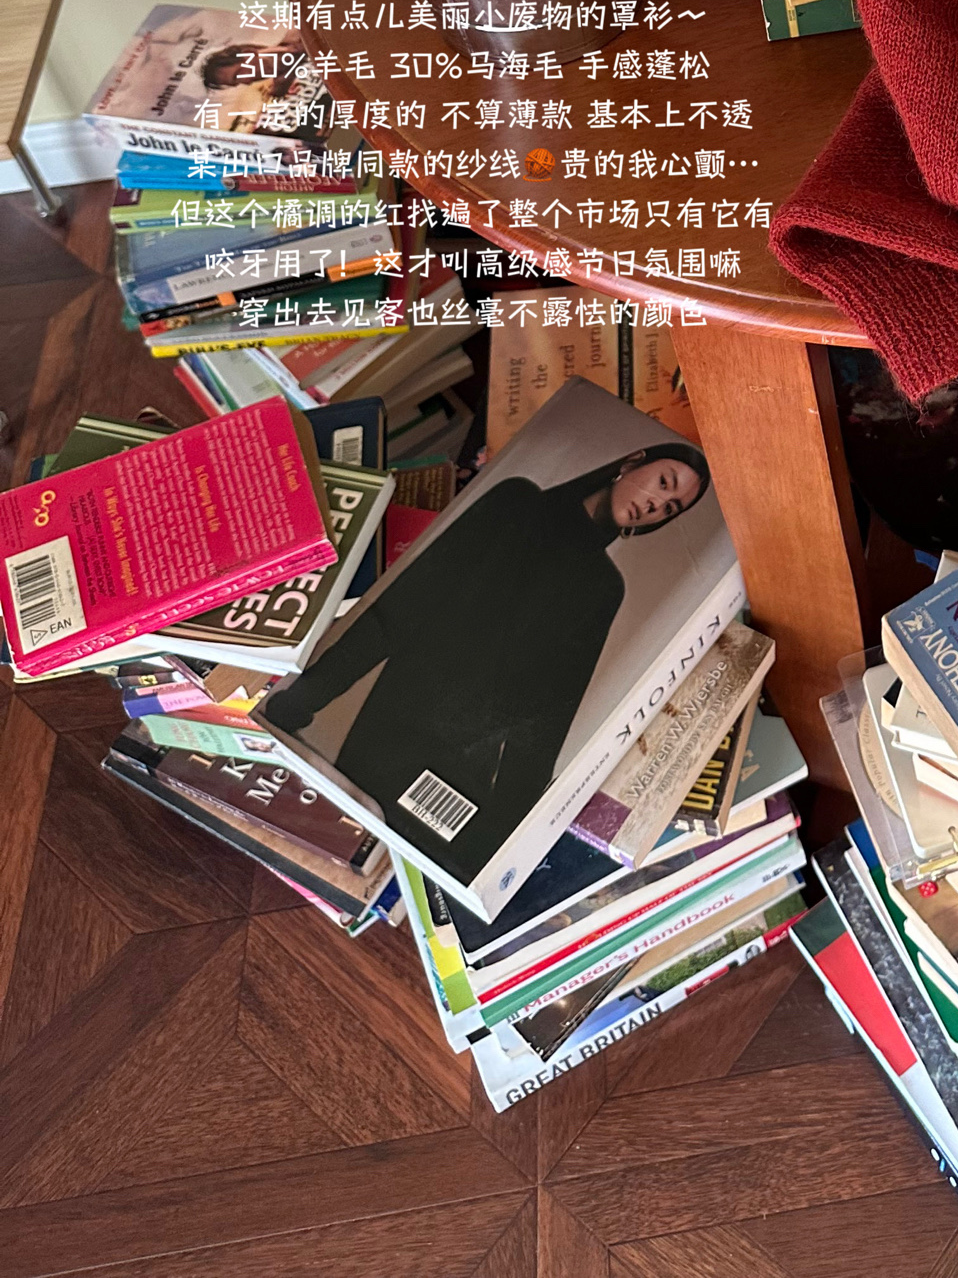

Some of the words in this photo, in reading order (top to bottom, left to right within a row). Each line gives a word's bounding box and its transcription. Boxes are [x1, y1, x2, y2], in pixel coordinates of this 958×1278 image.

[178, 38, 209, 71] Carré
[172, 67, 185, 85] le
[151, 79, 175, 117] John
[127, 133, 179, 151] John
[507, 357, 526, 417] writing
[532, 363, 549, 390] the
[276, 442, 291, 456] Her
[280, 456, 295, 471] Life
[284, 469, 301, 492] Coach
[48, 618, 73, 633] EAN
[616, 614, 723, 745] KINFOLK
[625, 739, 672, 801] Warren
[665, 717, 687, 743] W.
[680, 656, 728, 722] Wiersbe
[523, 945, 631, 1016] Manager's
[633, 890, 737, 953] Handbook
[506, 1053, 578, 1106] GREAT
[581, 1001, 664, 1062] BRITAIN
